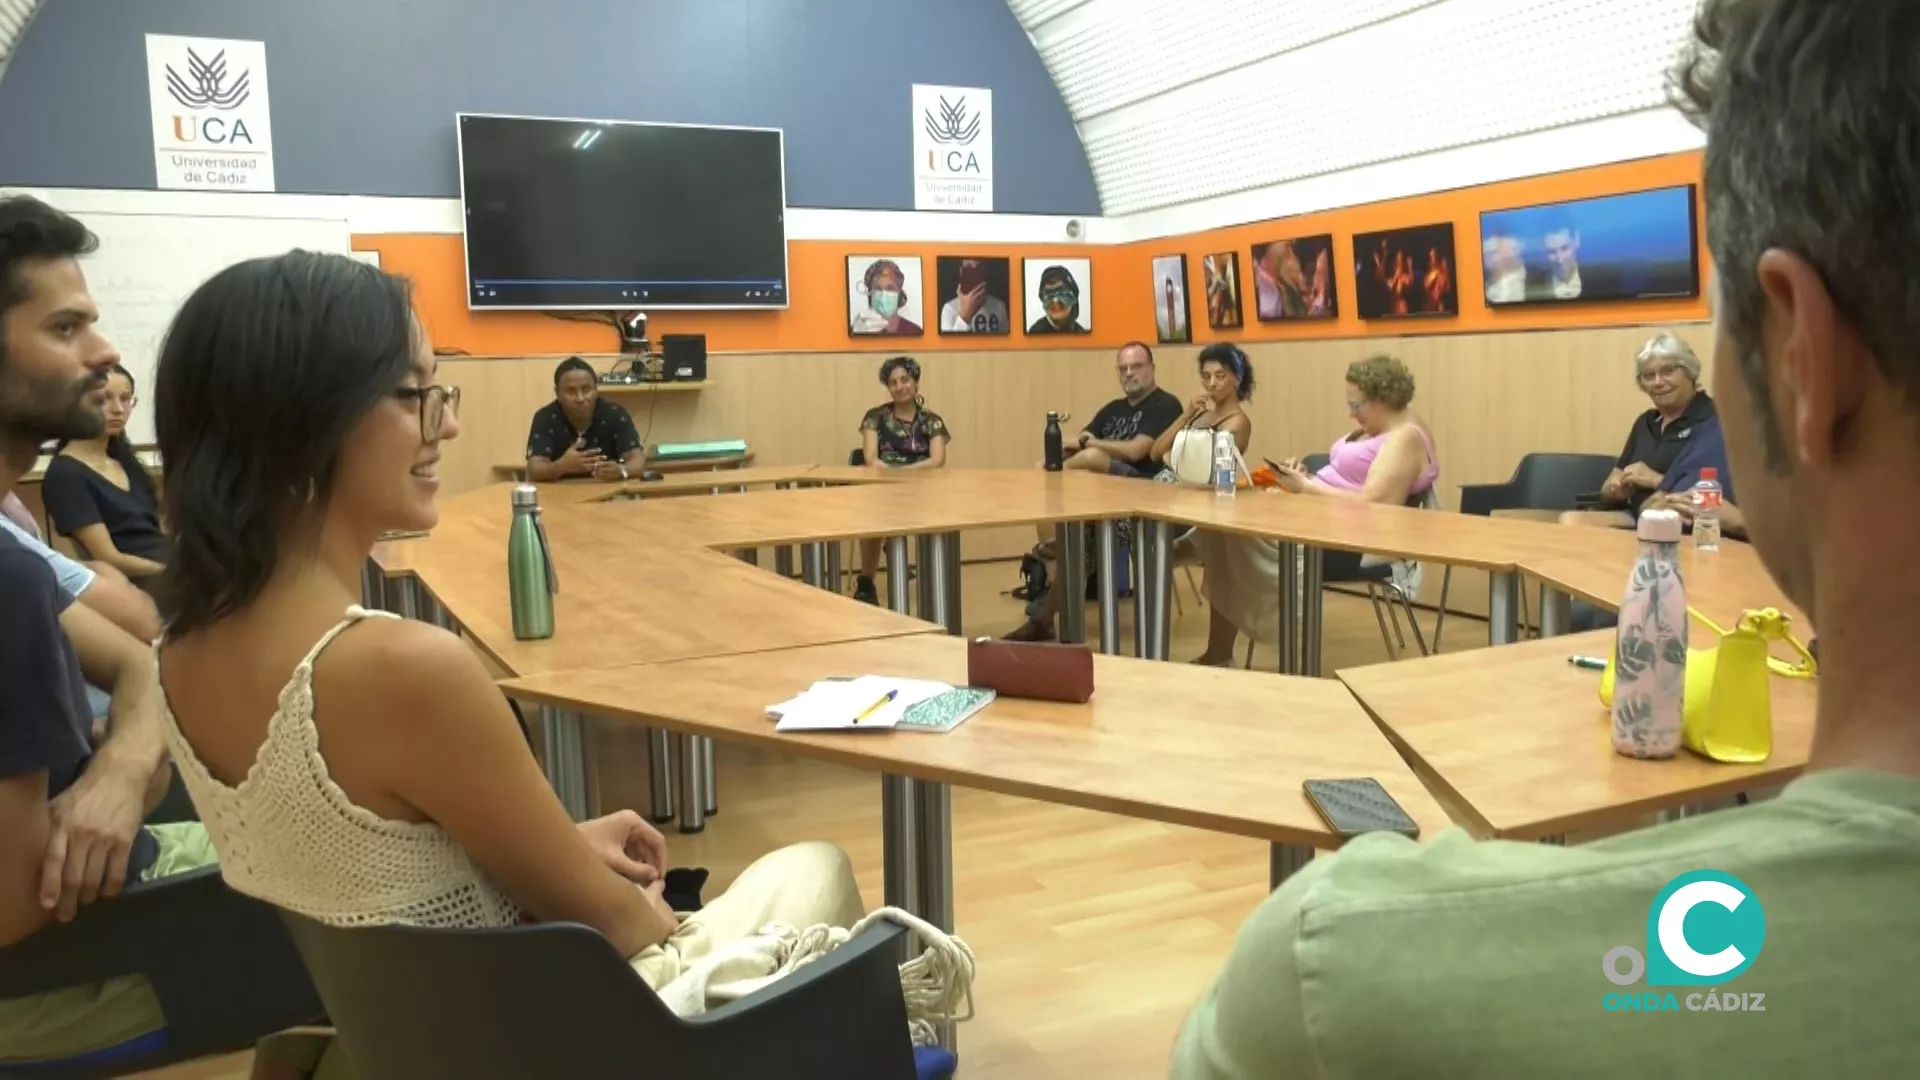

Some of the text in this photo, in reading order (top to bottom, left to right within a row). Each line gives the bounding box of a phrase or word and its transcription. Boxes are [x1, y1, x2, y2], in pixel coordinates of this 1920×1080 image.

[171, 115, 253, 144] UCA
[171, 155, 257, 169] Universidad
[928, 149, 980, 174] UCA
[184, 170, 247, 184] de Cádiz
